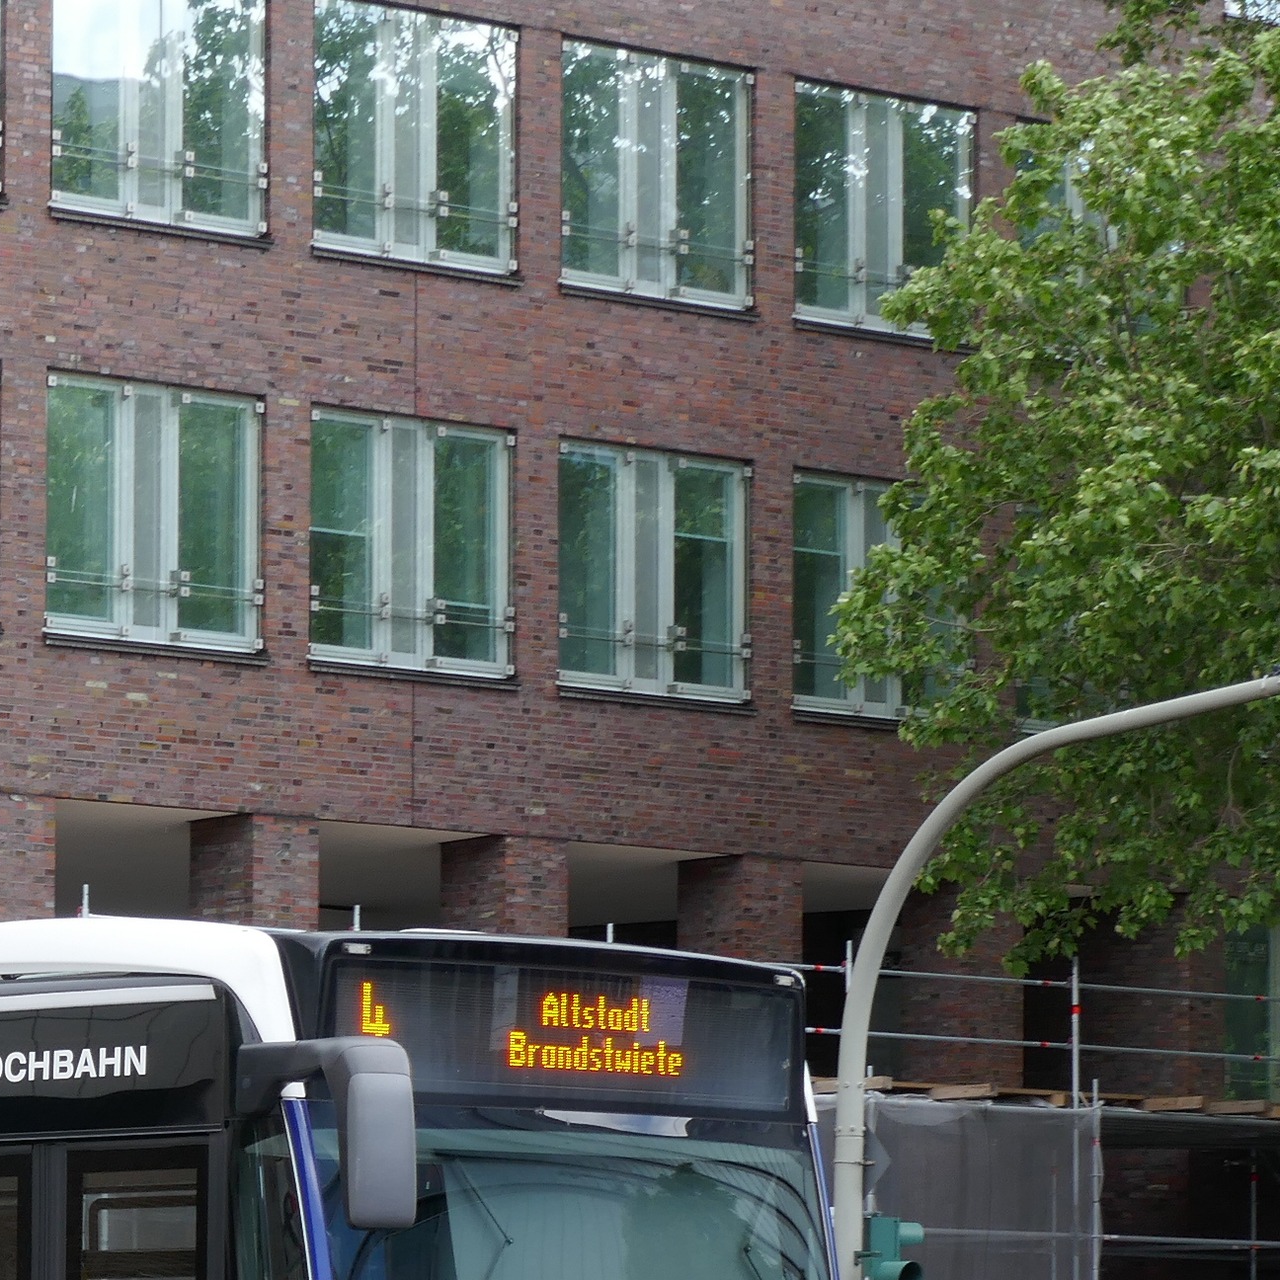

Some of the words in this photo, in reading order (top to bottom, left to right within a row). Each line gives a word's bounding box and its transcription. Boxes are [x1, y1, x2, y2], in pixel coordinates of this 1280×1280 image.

[361, 982, 391, 1037] 4
[541, 991, 650, 1033] Altstadt
[509, 1030, 683, 1077] Brandstwiete
